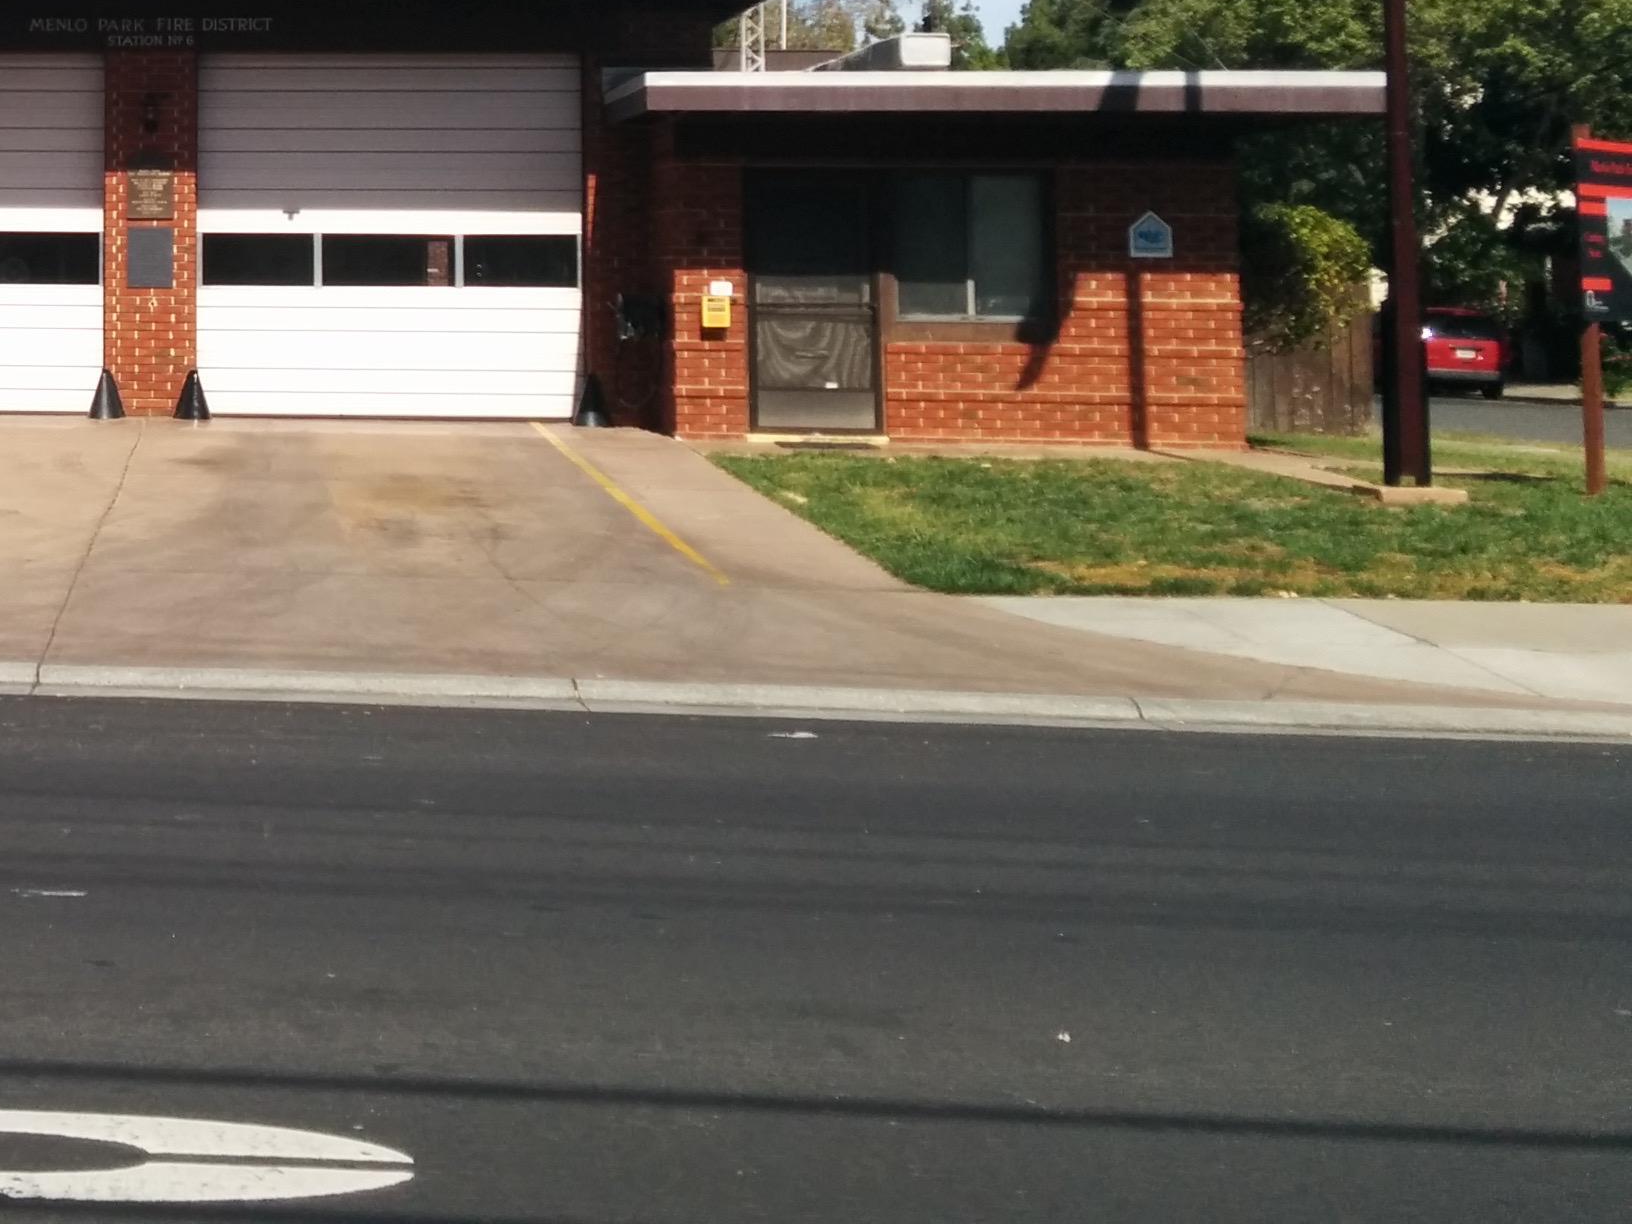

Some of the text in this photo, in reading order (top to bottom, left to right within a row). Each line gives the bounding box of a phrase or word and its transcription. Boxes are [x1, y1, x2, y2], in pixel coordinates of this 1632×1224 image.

[29, 17, 273, 32] MENLO PARK FIRE DISTRICT
[108, 35, 163, 47] STATION
[186, 36, 194, 46] 6
